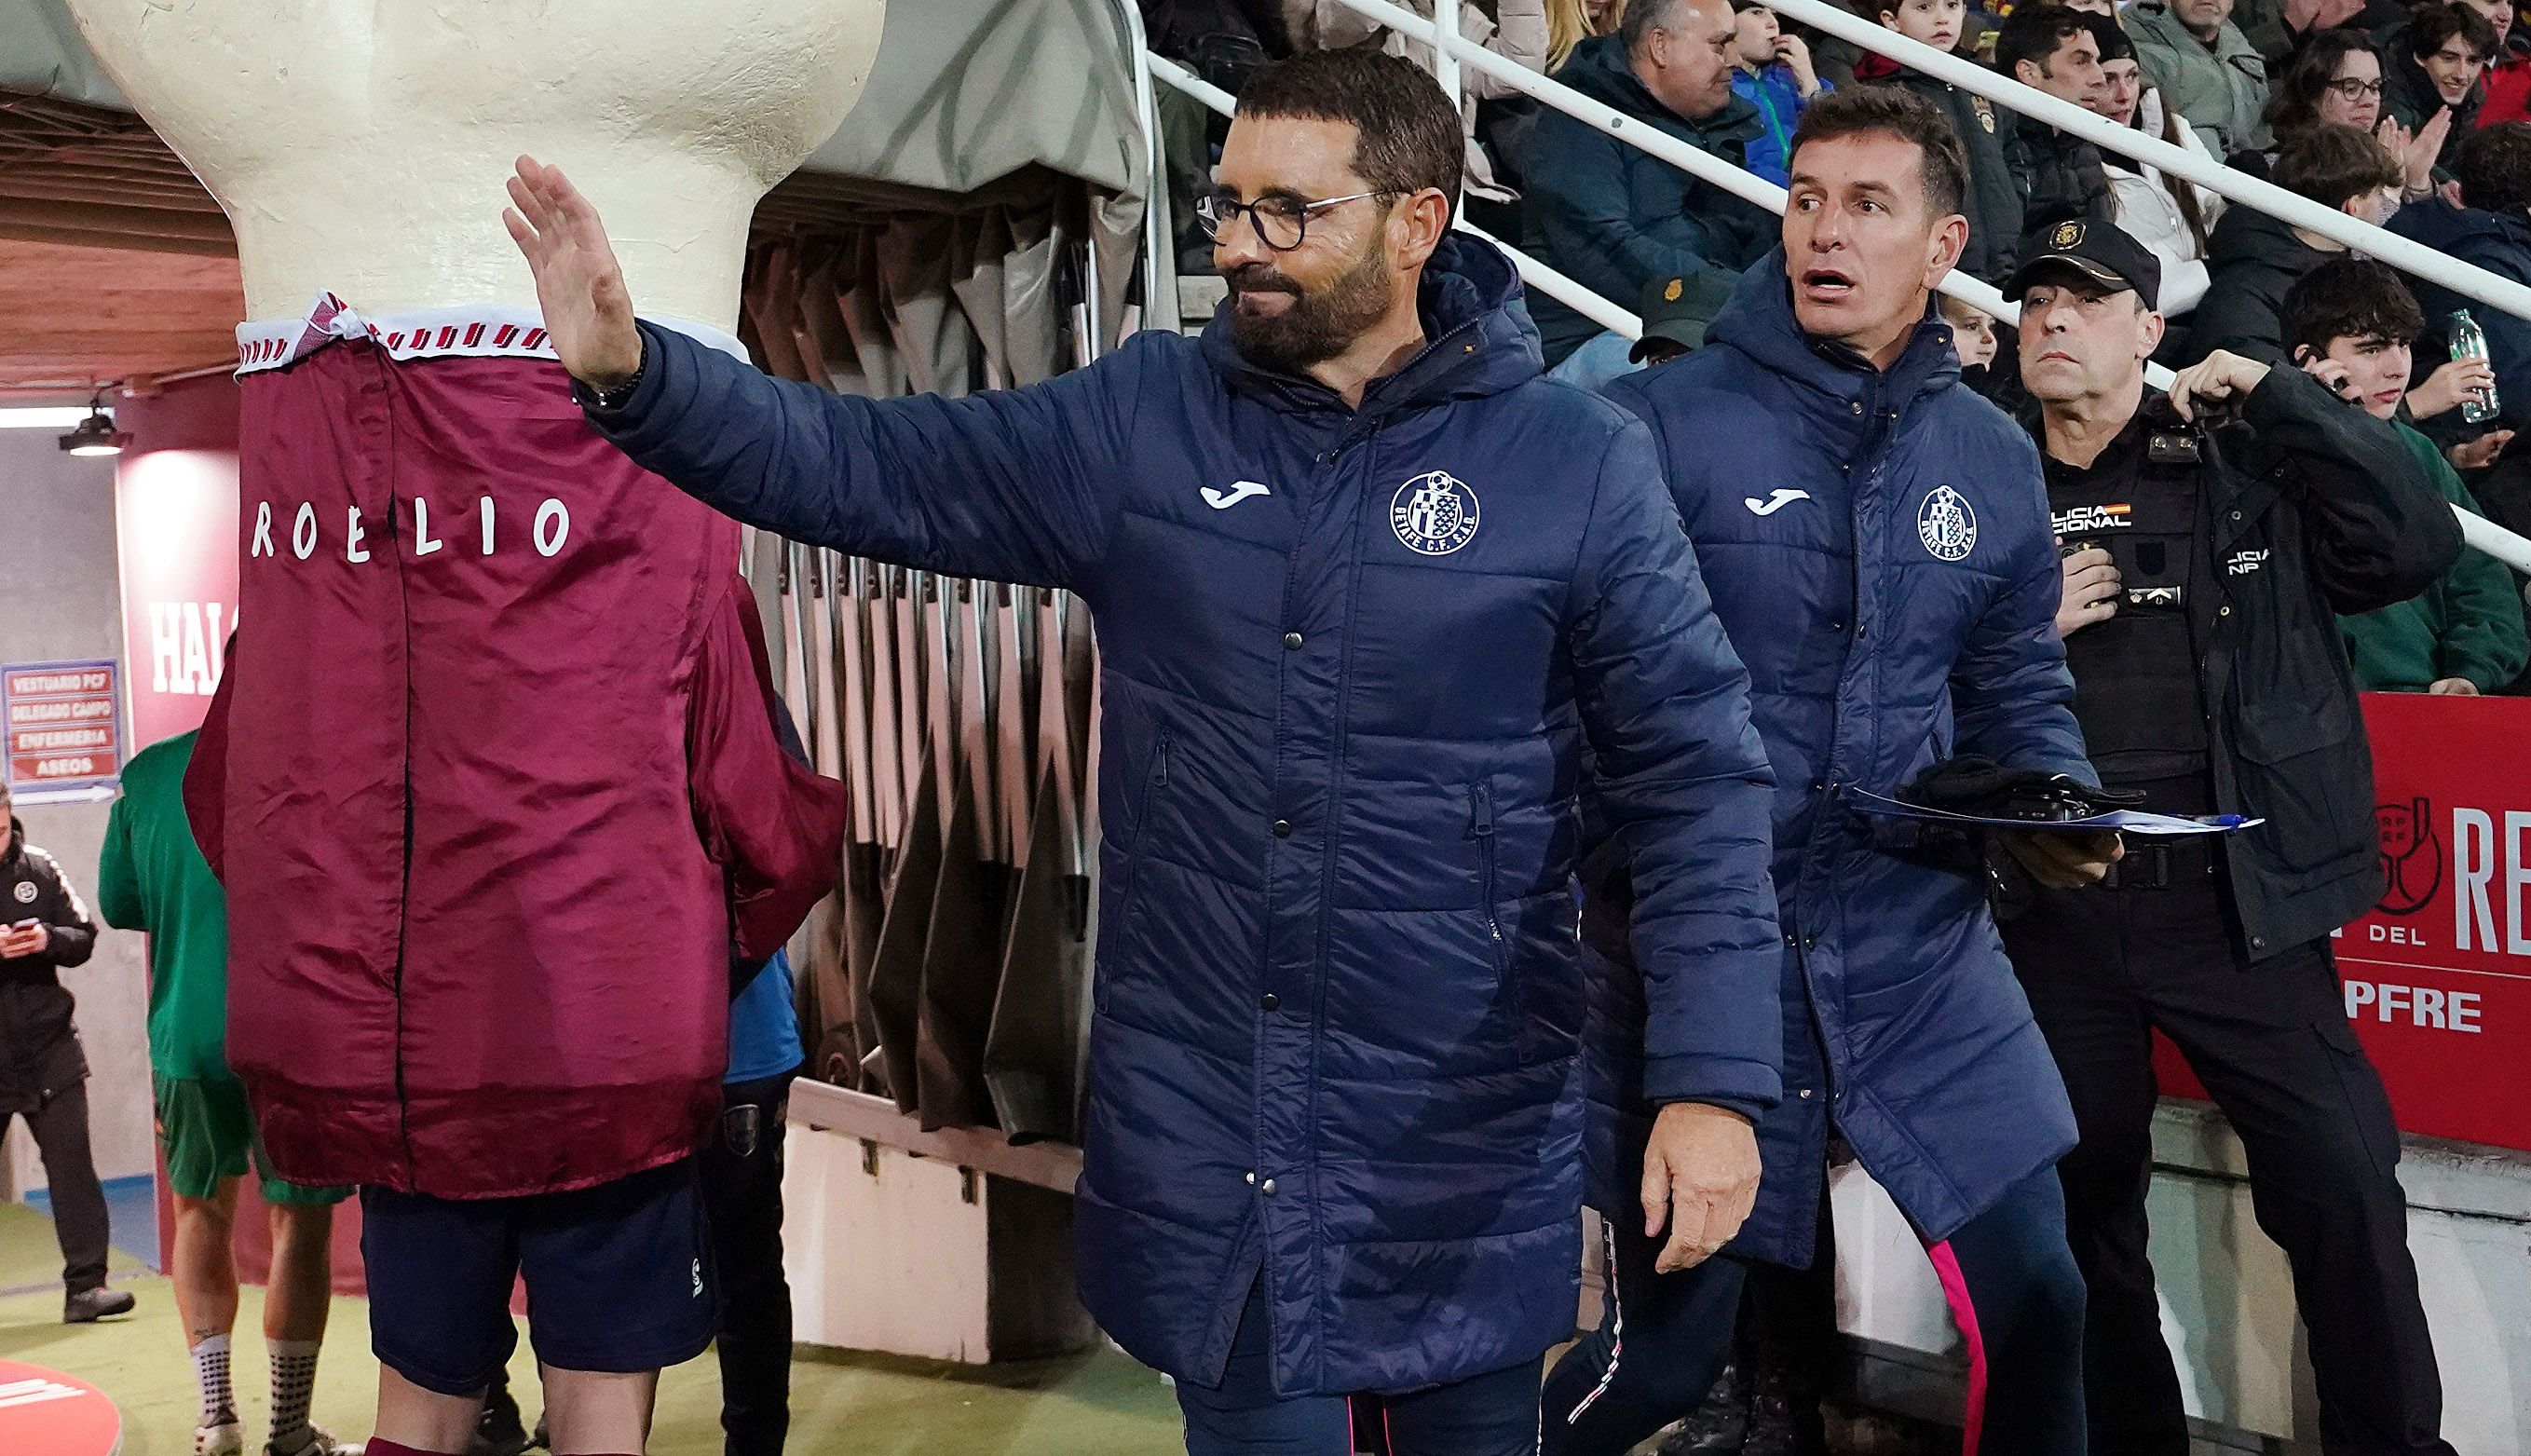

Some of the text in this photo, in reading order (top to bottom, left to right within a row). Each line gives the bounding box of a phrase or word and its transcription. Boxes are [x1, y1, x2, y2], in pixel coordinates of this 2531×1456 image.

[252, 496, 569, 563] ROELIO
[1395, 507, 1476, 551] GETAFE C.F. S.A.D.
[14, 674, 81, 693] VESTUARIO
[12, 701, 111, 720] DELEGADO CAMPO
[36, 757, 92, 775] ASEOS
[2369, 807, 2531, 956] DEL RE
[2344, 980, 2482, 1033] PFRE
